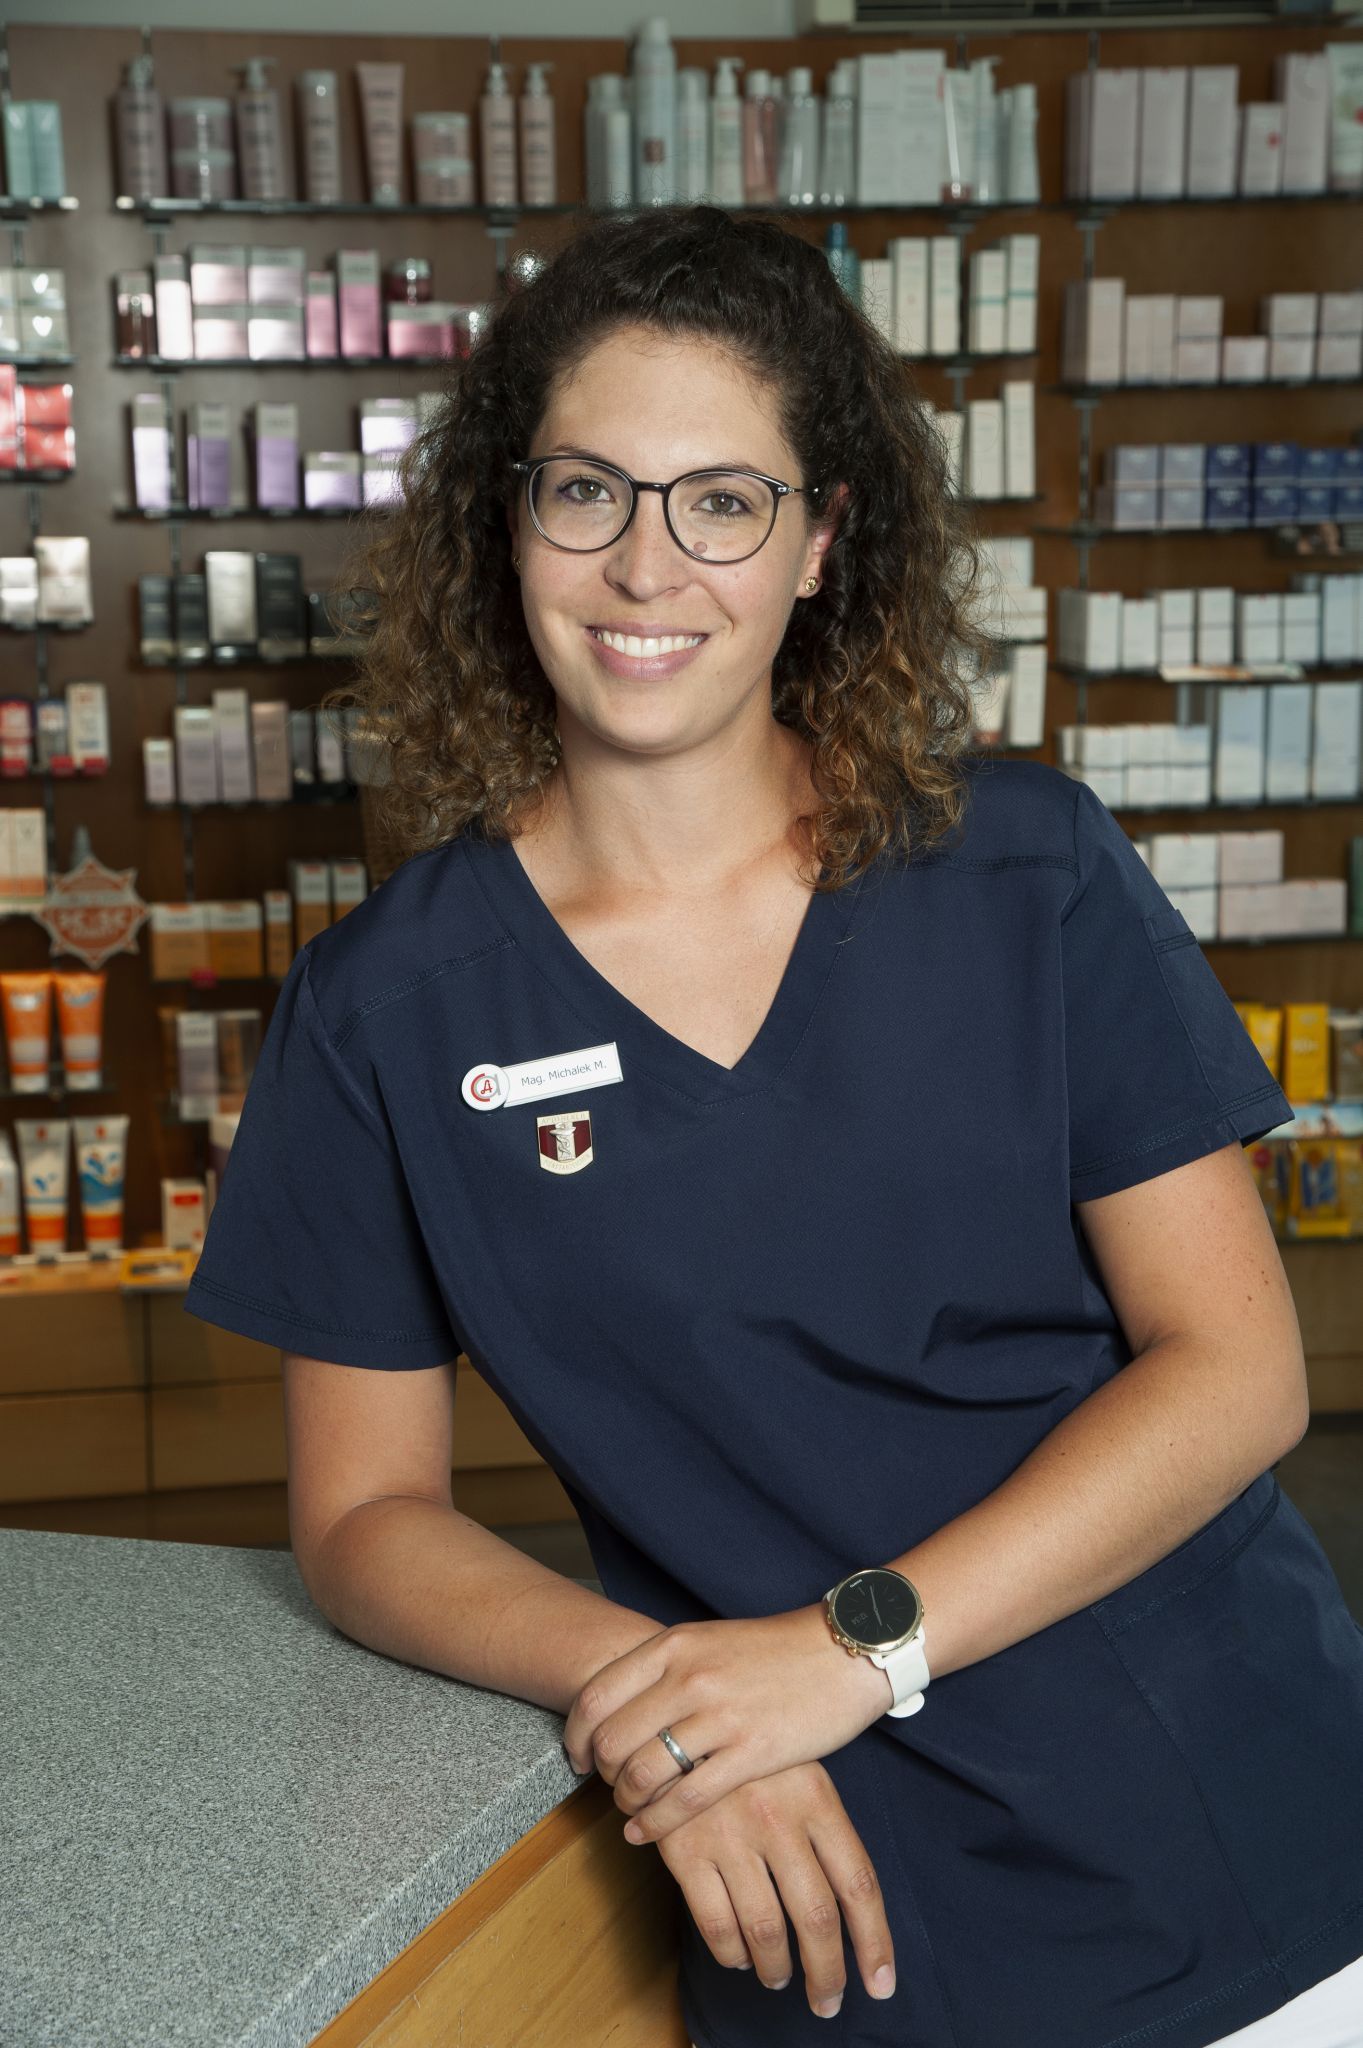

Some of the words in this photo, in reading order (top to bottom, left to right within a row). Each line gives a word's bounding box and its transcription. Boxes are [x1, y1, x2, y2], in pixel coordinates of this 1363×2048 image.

[521, 1077, 546, 1087] Mag.
[548, 1063, 592, 1081] Michalek
[594, 1060, 607, 1070] M.
